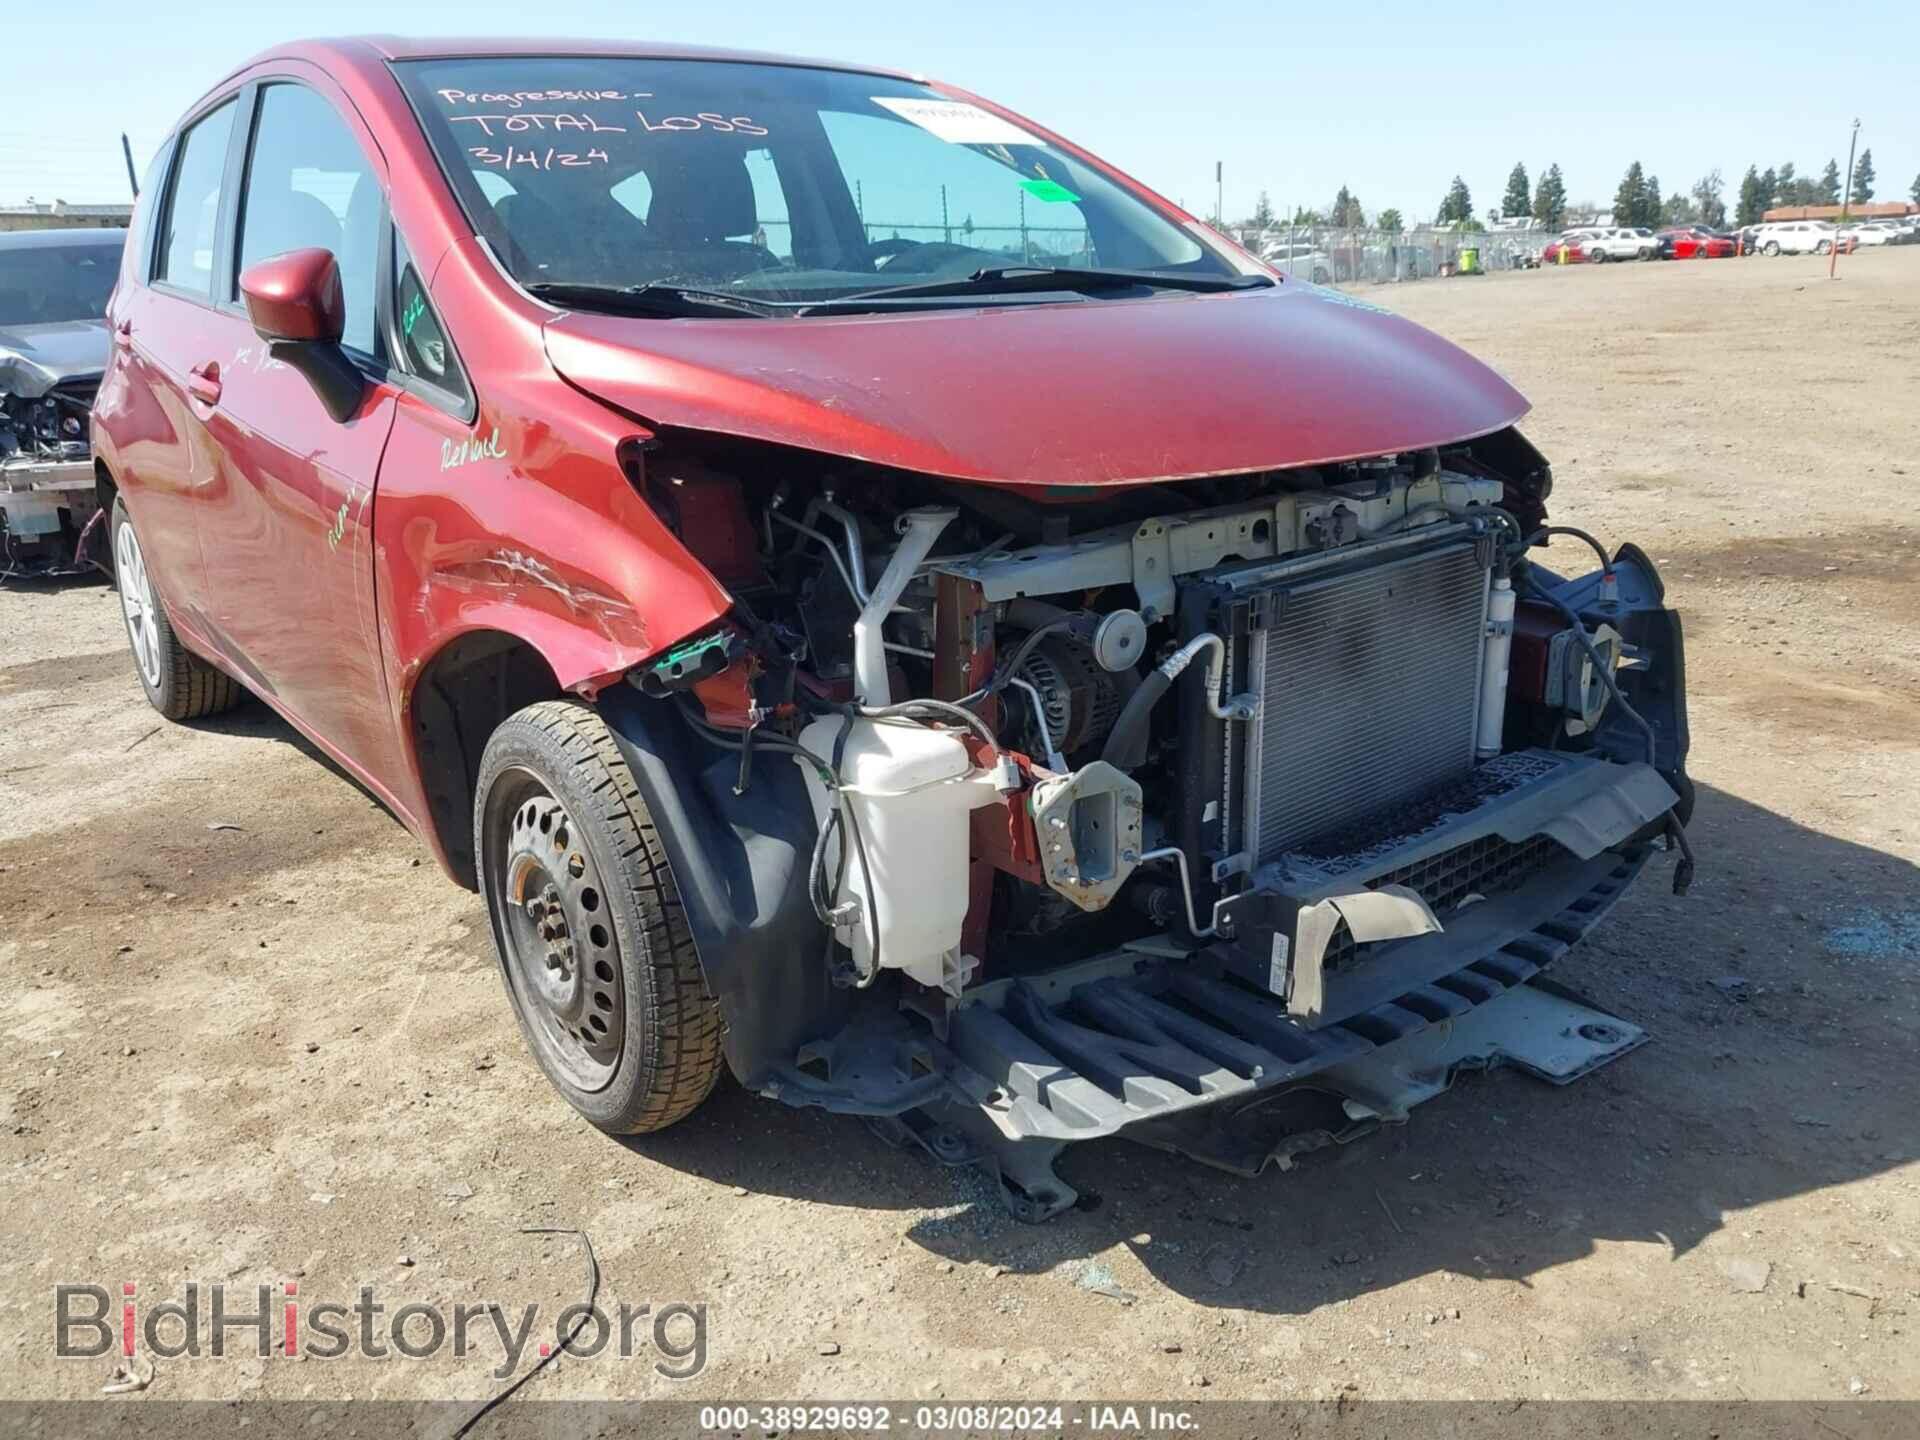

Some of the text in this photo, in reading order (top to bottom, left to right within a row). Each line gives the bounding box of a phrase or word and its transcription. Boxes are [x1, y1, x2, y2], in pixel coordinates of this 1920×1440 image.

[438, 88, 626, 107] Progressive
[450, 112, 768, 136] TOTAL LOSS
[469, 147, 609, 170] 3/4/24
